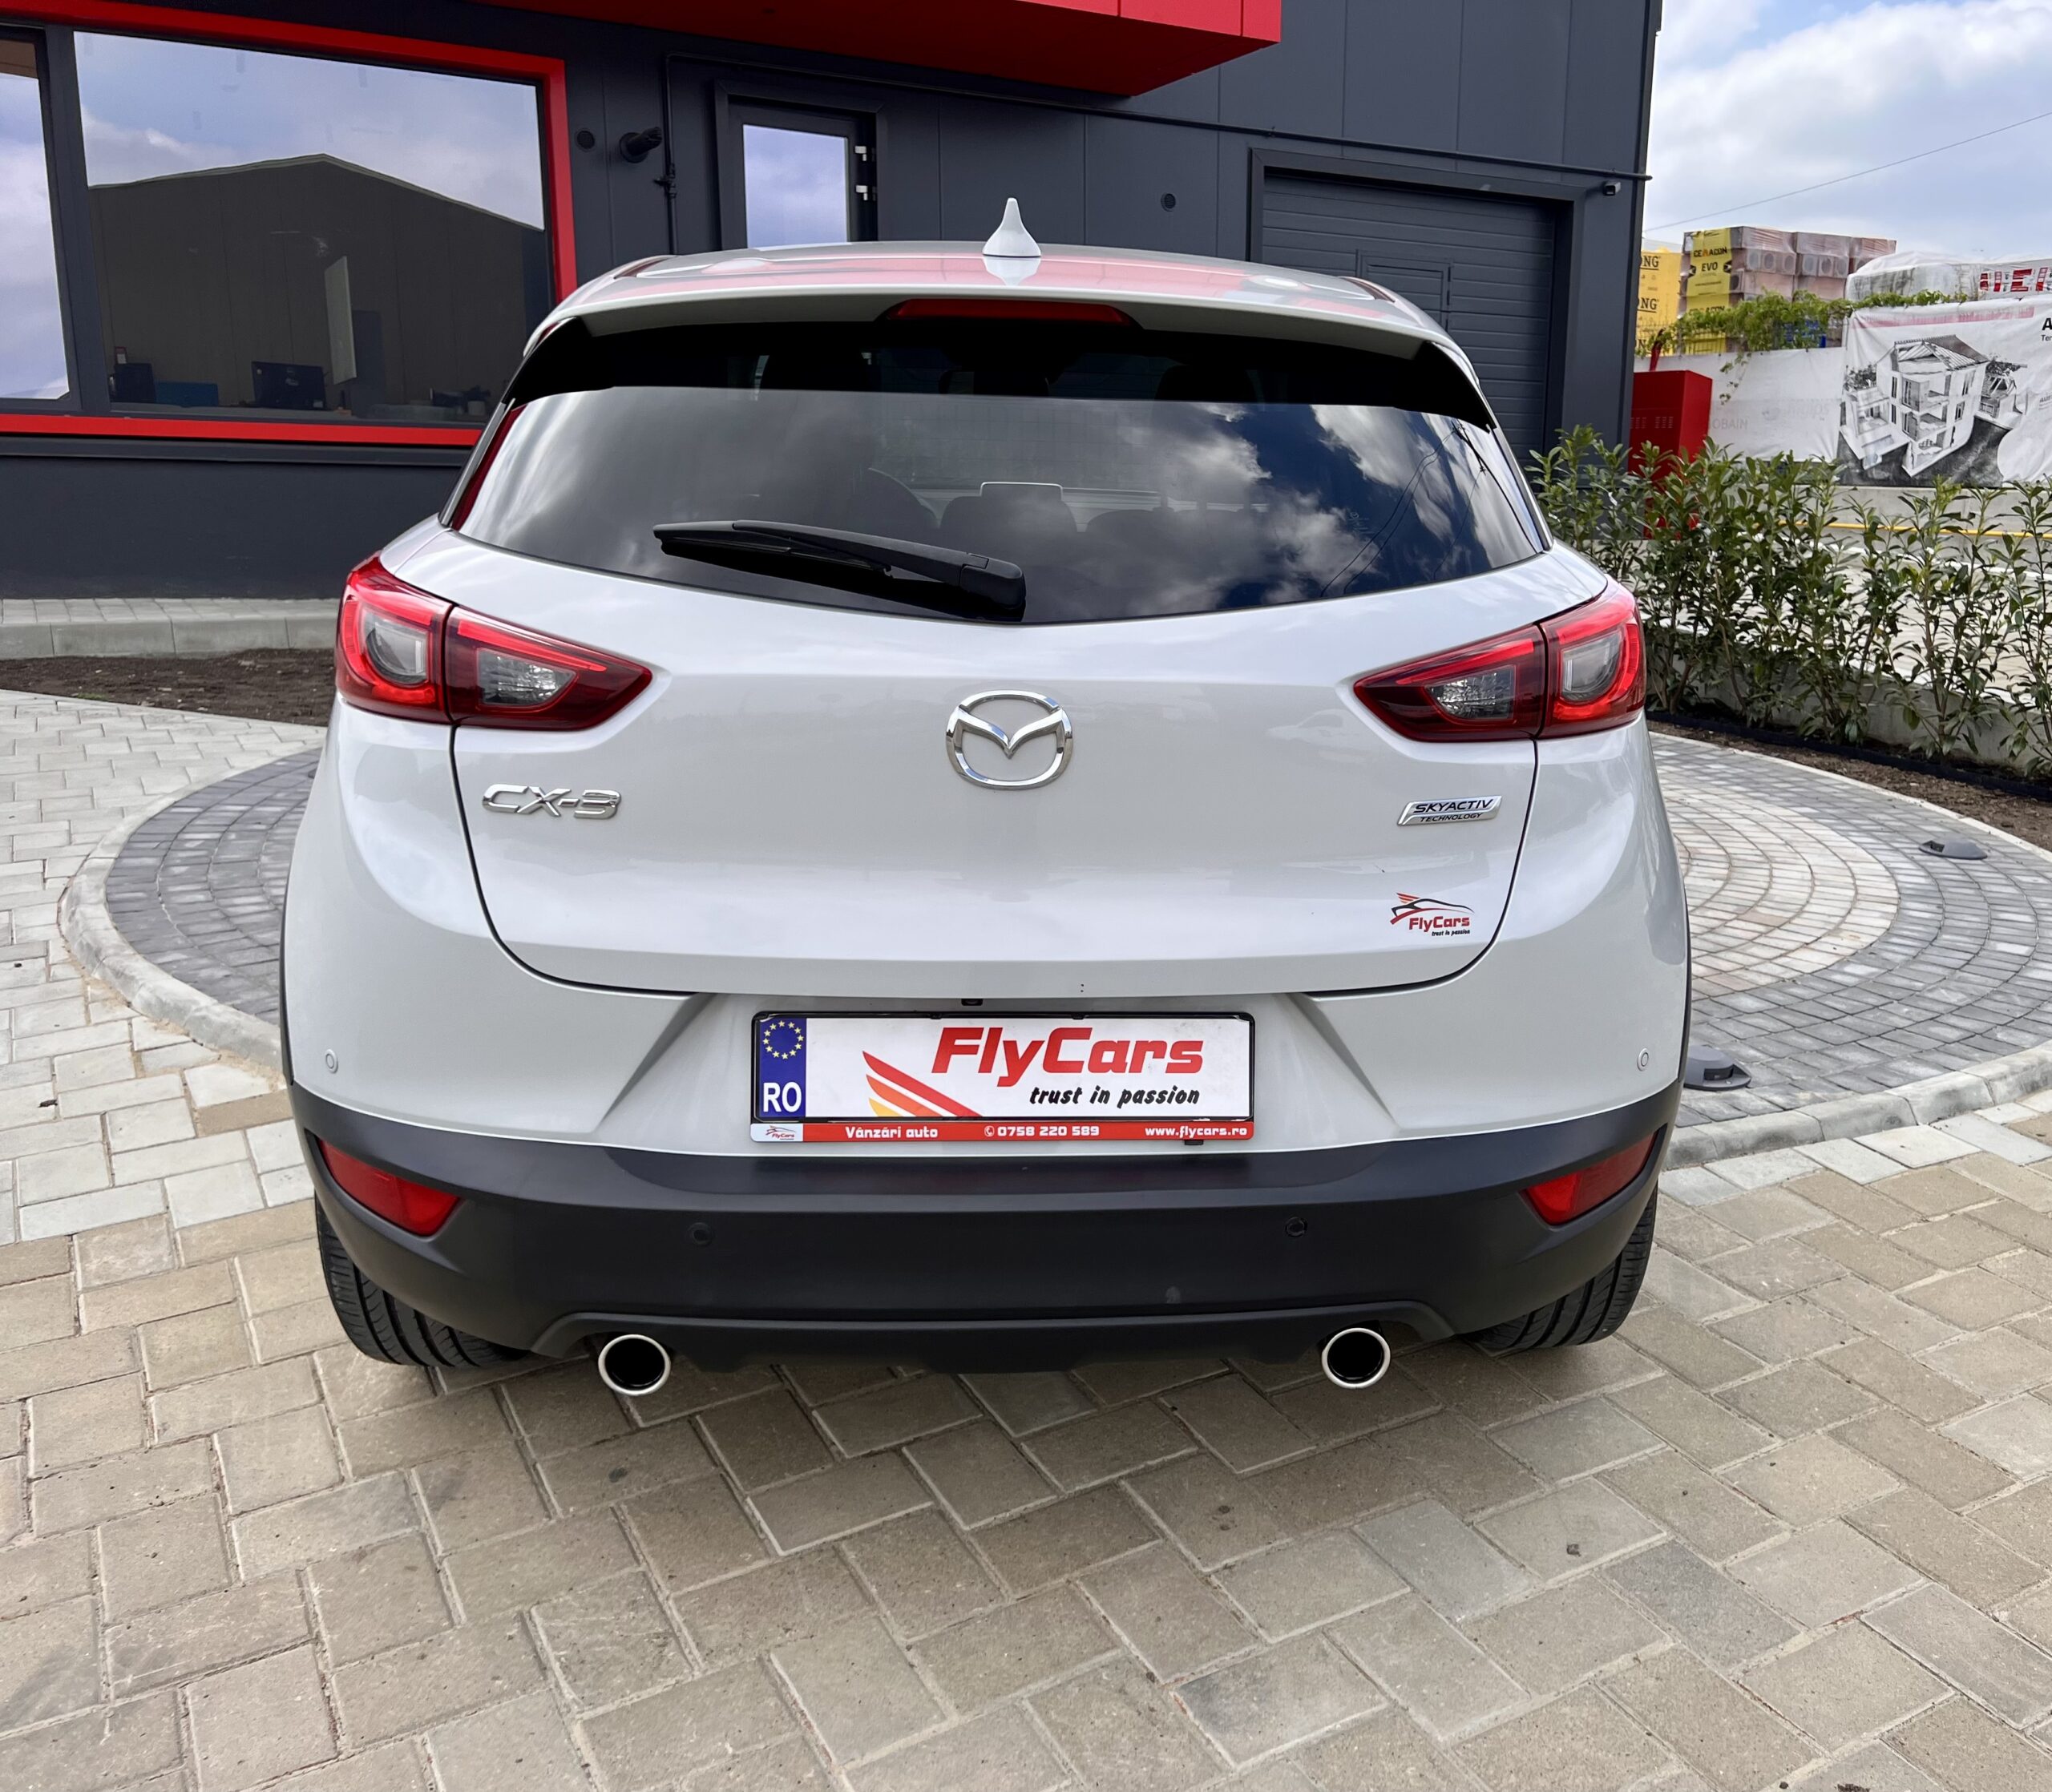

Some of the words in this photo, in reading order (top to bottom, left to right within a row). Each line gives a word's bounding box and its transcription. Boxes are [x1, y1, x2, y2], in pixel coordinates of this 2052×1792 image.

[1640, 256, 1659, 268] NG
[1702, 262, 1719, 272] EVO
[1637, 297, 1657, 310] NG
[483, 783, 621, 819] CX-3
[1413, 799, 1493, 813] SKYACTIV
[1420, 813, 1483, 822] TECHNOLOGY
[1409, 916, 1470, 932] FlyCars
[931, 1027, 1204, 1088] FlyCars
[763, 1082, 802, 1112] RO
[1030, 1087, 1082, 1104] trust
[1089, 1085, 1111, 1104] in
[1117, 1085, 1200, 1108] passion
[845, 1125, 902, 1138] Vânzări
[906, 1127, 939, 1138] auto
[997, 1126, 1035, 1136] 0758
[1039, 1126, 1067, 1136] 220
[1072, 1126, 1100, 1136] 589
[1145, 1125, 1247, 1138] www.flycars.ro
